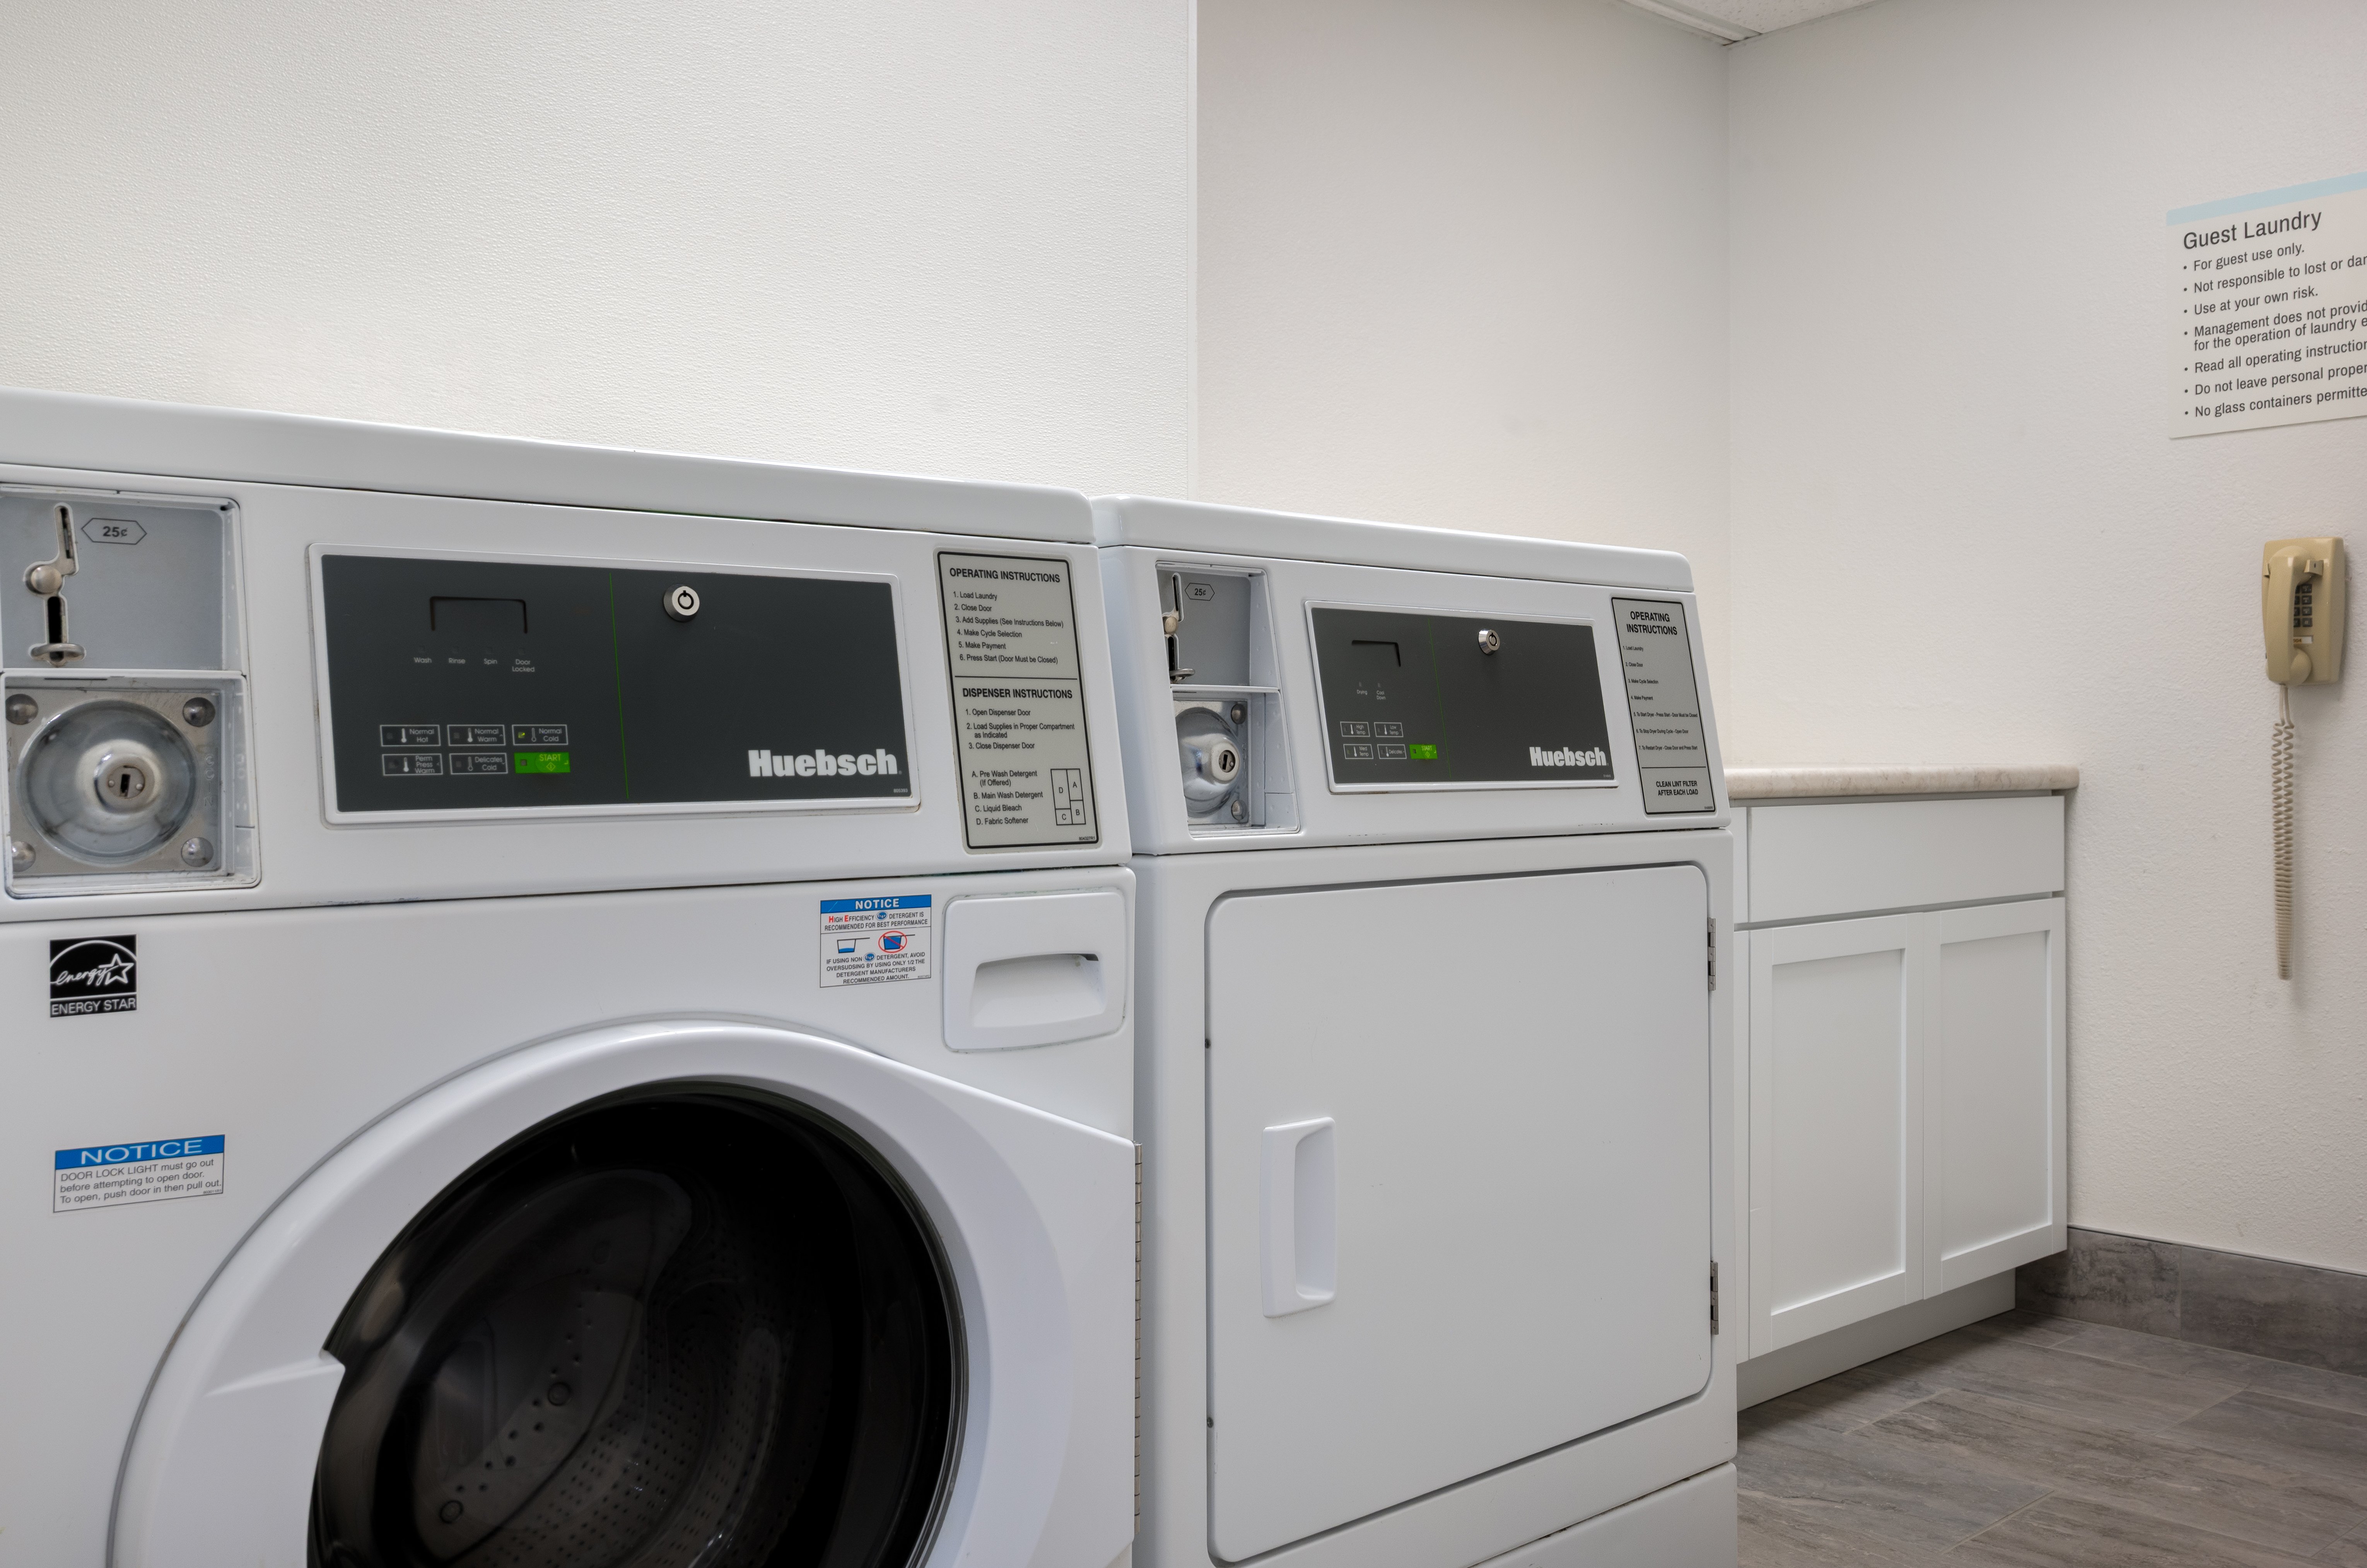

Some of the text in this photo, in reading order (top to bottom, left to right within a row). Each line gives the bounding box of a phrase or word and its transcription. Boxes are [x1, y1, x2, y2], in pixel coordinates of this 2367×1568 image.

[2184, 211, 2322, 249] Guest Laundry
[2194, 243, 2304, 271] For guest use only.
[2194, 260, 2343, 293] Not responsible to lost or
[2195, 285, 2318, 315] Use at your own risk.
[2195, 299, 2367, 337] Management does not provid
[2195, 358, 2224, 373] Read
[2228, 355, 2241, 369] all
[2246, 348, 2302, 367] operating
[2195, 384, 2210, 395] Do
[2215, 380, 2233, 393] not
[2237, 377, 2267, 390] leave
[2271, 367, 2323, 388] personal
[2195, 386, 2367, 417] No glass containers permitte
[102, 526, 127, 538] 25¢
[950, 567, 1060, 583] OPERATING INSTRUCTIONS
[975, 592, 997, 601] Laundry
[1194, 588, 1206, 596] 25¢
[975, 617, 999, 625] Supplies
[999, 618, 1013, 626] (See
[1014, 618, 1045, 627] Instructions
[1045, 620, 1064, 629] Below)
[1630, 611, 1670, 622] OPERATING
[1626, 623, 1677, 635] INSTRUCTIONS
[982, 642, 1006, 651] Payment
[962, 688, 1072, 699] DISPENSER INSTRUCTIONS
[972, 708, 988, 717] Open
[989, 709, 1016, 717] Dispenser
[989, 723, 1013, 731] Supplies
[1020, 723, 1038, 731] Proper
[1039, 723, 1075, 731] Compartment
[748, 748, 898, 777] Huebsch
[1529, 746, 1607, 767] Huebsch
[855, 898, 899, 909] NOTICE
[825, 923, 864, 931] RECOMMENDED
[891, 919, 928, 927] PERFORMANCE
[55, 965, 108, 986] energy
[870, 966, 916, 975] MANUFACTURERS
[51, 998, 136, 1016] ENERGY STAR
[81, 1139, 203, 1165] NOTICE
[61, 1158, 214, 1182] DOOR LOCK LIGHT must go out
[60, 1184, 91, 1193] before
[93, 1176, 143, 1190] attempting
[157, 1174, 179, 1184] open
[182, 1172, 205, 1180] door.
[60, 1195, 71, 1204] To
[74, 1194, 101, 1204] open,
[104, 1189, 126, 1201] push
[130, 1188, 151, 1196] door
[186, 1180, 203, 1192] pull
[205, 1179, 222, 1188] out.
